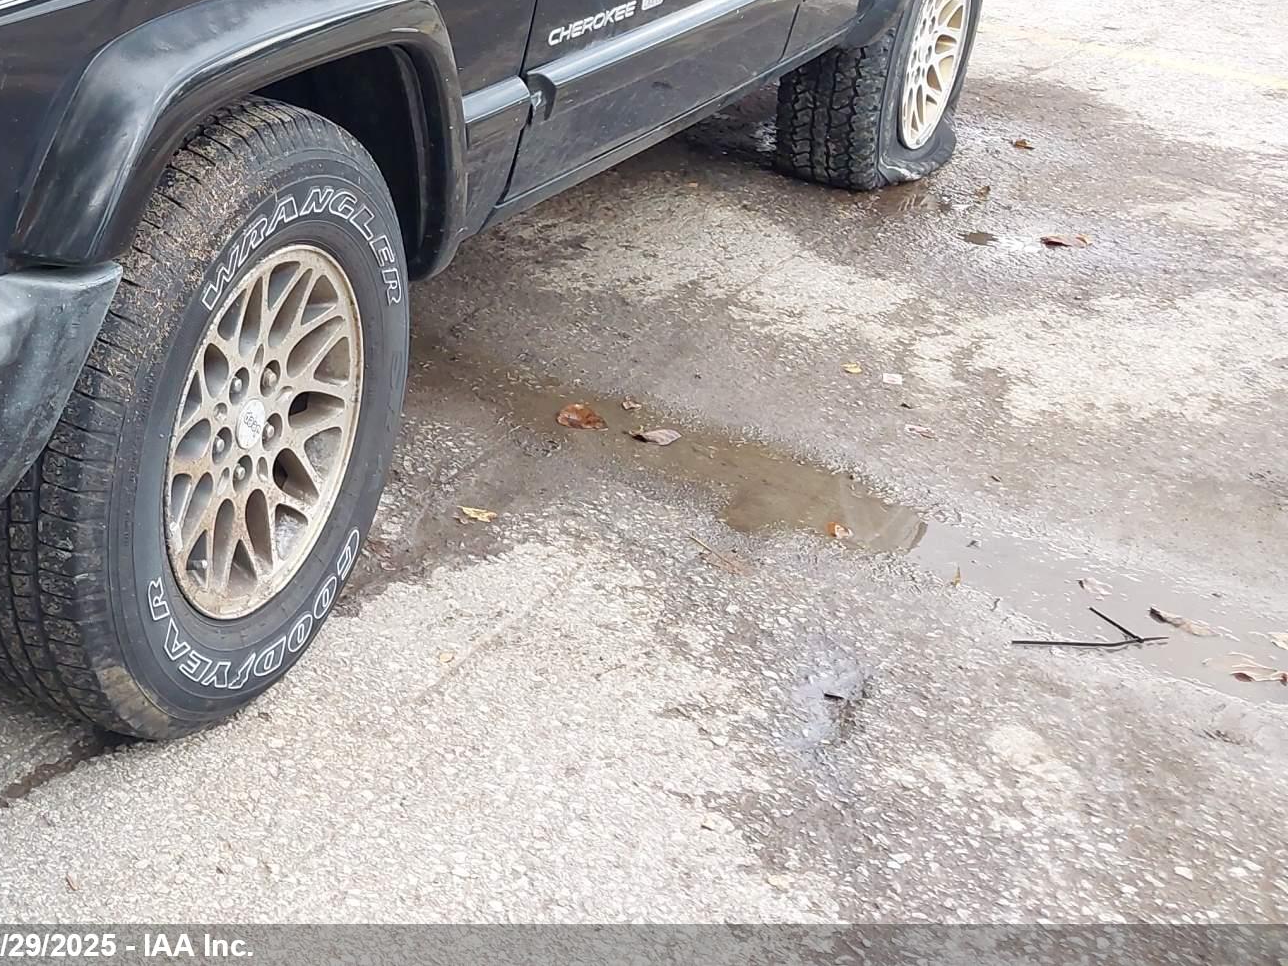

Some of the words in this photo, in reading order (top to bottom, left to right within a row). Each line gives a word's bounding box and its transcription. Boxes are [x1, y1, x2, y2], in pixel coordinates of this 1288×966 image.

[547, 0, 638, 46] CHEROKEE
[201, 186, 402, 311] WRANGLER
[147, 528, 361, 690] GOODYEAR
